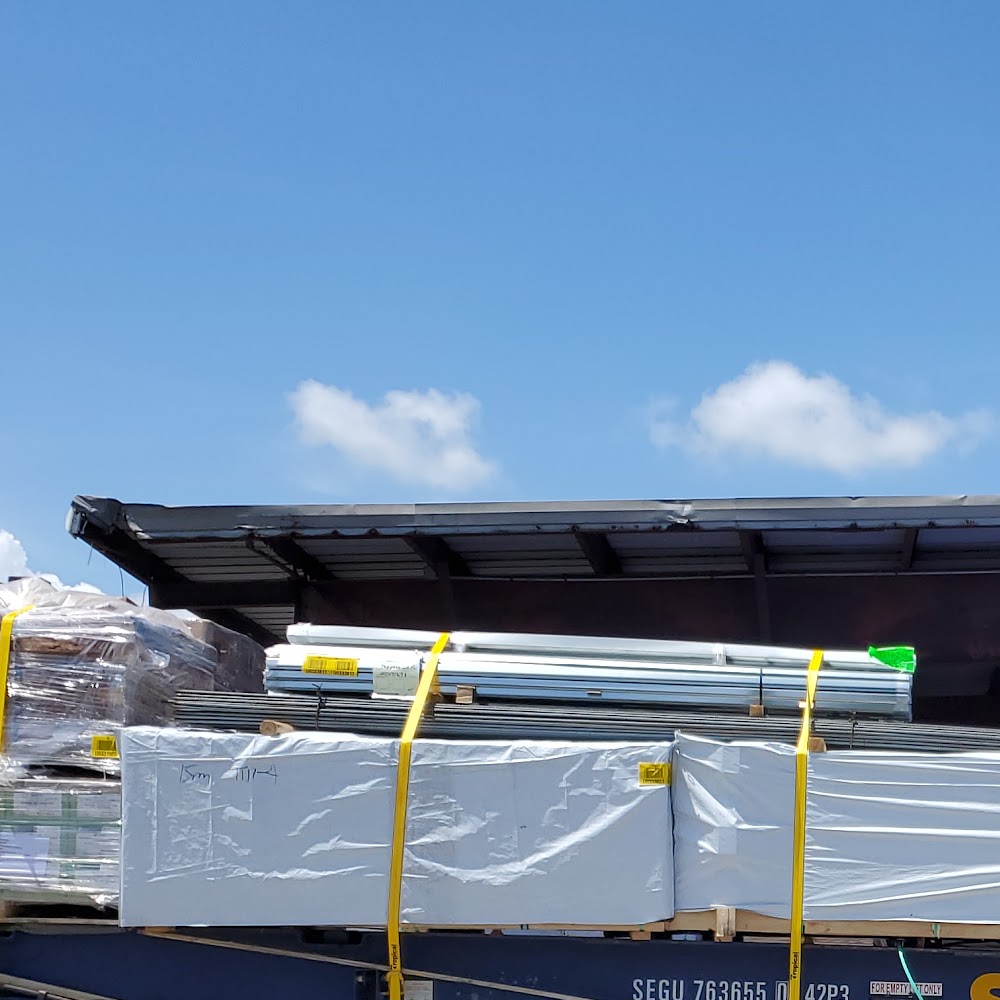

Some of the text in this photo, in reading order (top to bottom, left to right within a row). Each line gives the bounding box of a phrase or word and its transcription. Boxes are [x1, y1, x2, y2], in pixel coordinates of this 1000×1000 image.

[871, 982, 885, 993] FOR
[886, 983, 908, 994] EMPTY
[924, 984, 942, 995] ONLY
